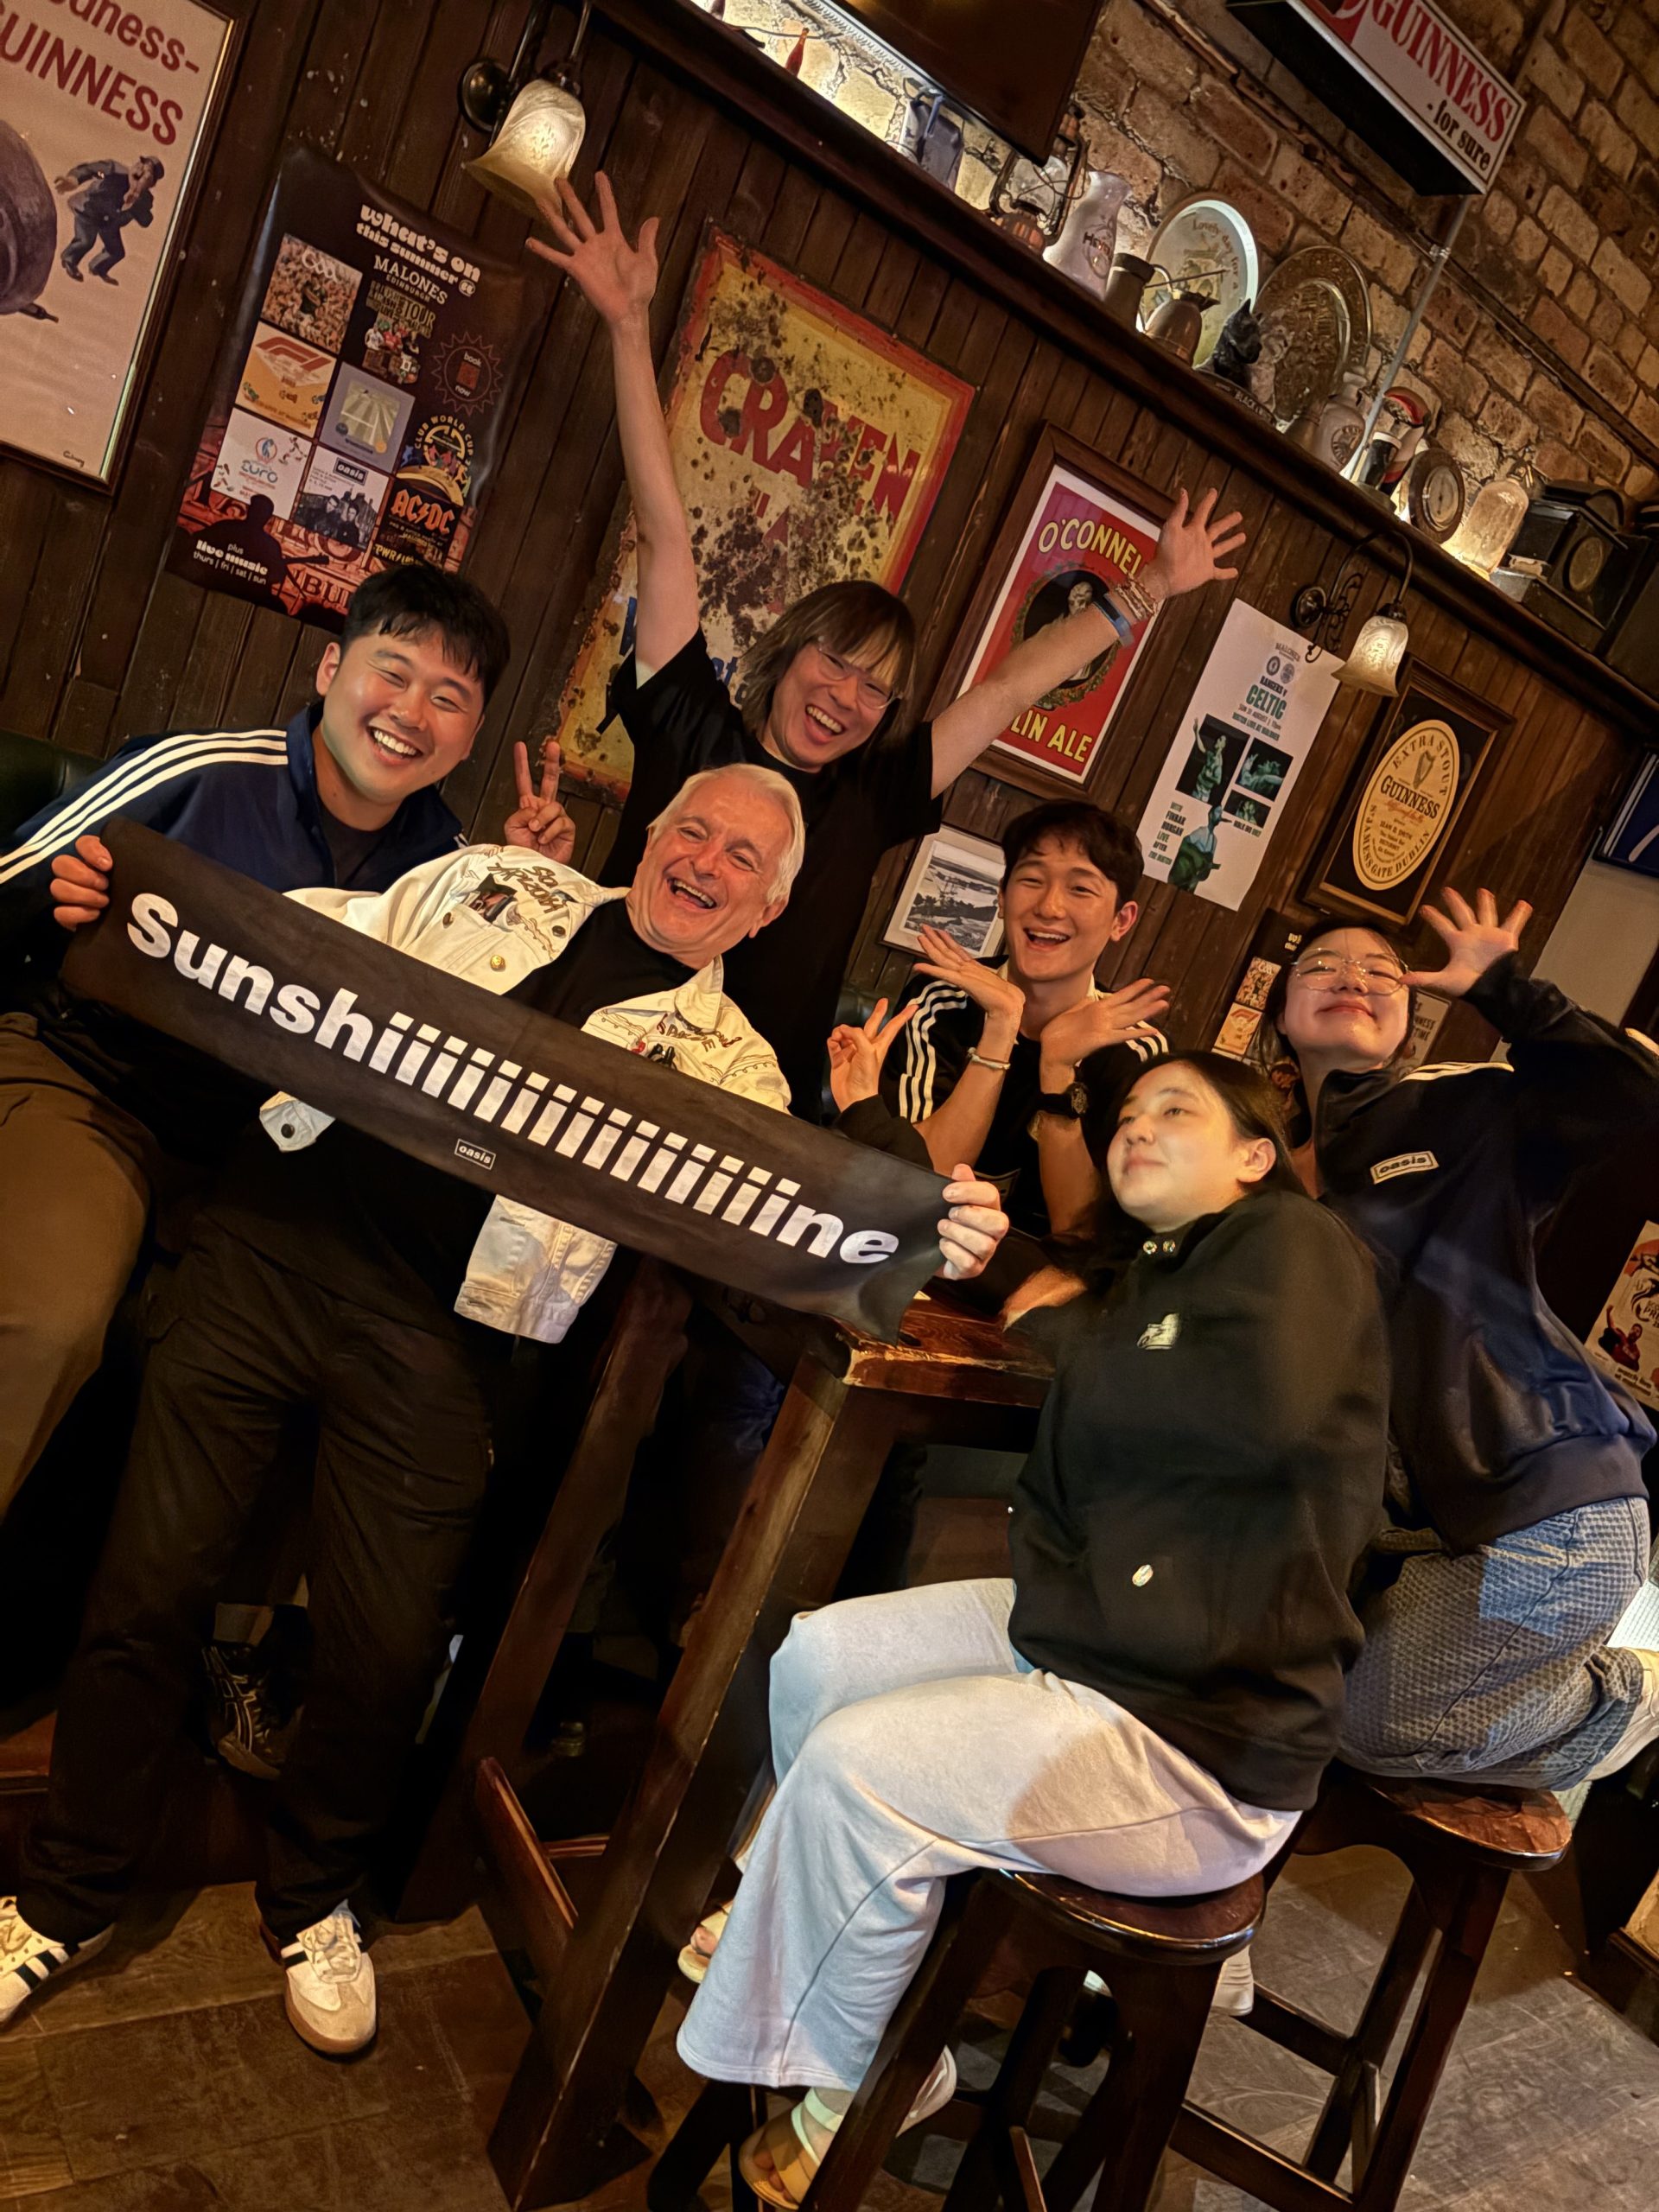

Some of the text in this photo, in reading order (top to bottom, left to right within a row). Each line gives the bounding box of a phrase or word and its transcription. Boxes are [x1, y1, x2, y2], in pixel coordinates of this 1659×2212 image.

[47, 0, 200, 73] dness-
[0, 10, 183, 145] UINNESS
[1457, 130, 1491, 171] sure
[356, 222, 390, 248] this
[390, 242, 459, 284] summer
[360, 204, 481, 283] what's on
[373, 254, 448, 305] MALONES
[386, 274, 431, 302] EDINBURGH
[463, 352, 482, 366] book
[454, 385, 471, 397] now
[414, 415, 474, 456] CLUB WORLD CUP
[196, 539, 268, 575] live music
[227, 543, 244, 555] plus
[1038, 518, 1141, 575] O'CONNEL
[194, 550, 214, 566] thurs
[220, 561, 229, 571] fri
[235, 567, 247, 579] sat
[253, 574, 267, 585] sun
[1245, 683, 1287, 720] CELTIC
[1010, 709, 1093, 763] LIN ALE
[1392, 734, 1434, 770] EXTRA
[1436, 740, 1451, 796] STOUT
[1380, 774, 1441, 819] GUINNESS
[1395, 830, 1430, 874] DUBLIN
[459, 1146, 492, 1164] oasis
[1379, 1155, 1427, 1173] oasis
